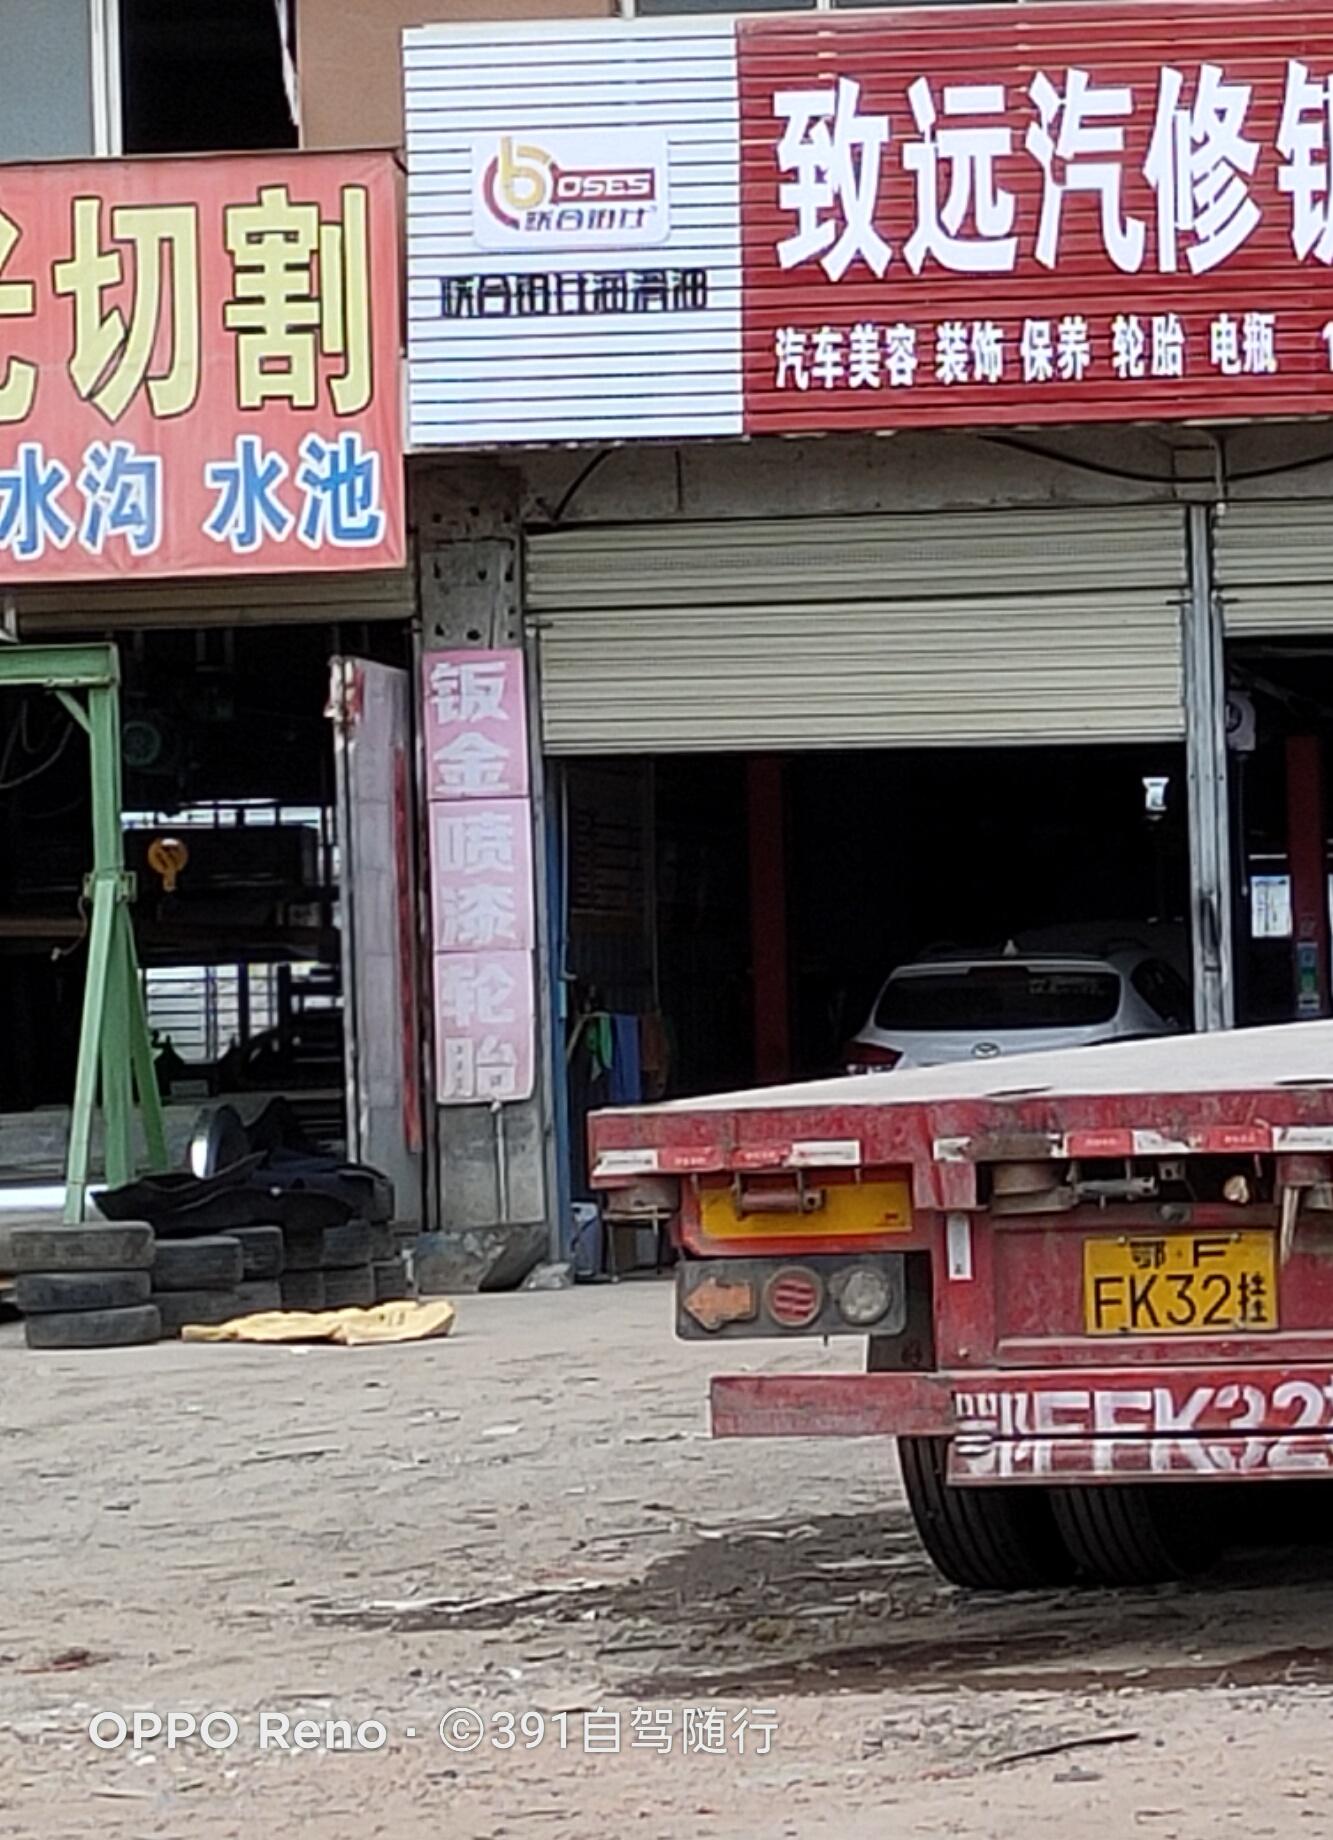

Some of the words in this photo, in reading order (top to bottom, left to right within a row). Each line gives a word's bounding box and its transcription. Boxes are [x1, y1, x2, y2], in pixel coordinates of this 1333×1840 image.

[775, 322, 917, 389] 汽车美容
[936, 321, 1003, 384] 装饰
[1020, 315, 1091, 381] 保养
[1112, 313, 1185, 379] 轮胎
[1210, 312, 1277, 374] 电瓶
[0, 445, 160, 558] 水沟
[205, 437, 384, 554] 水池
[1094, 1271, 1268, 1329] FK32挂
